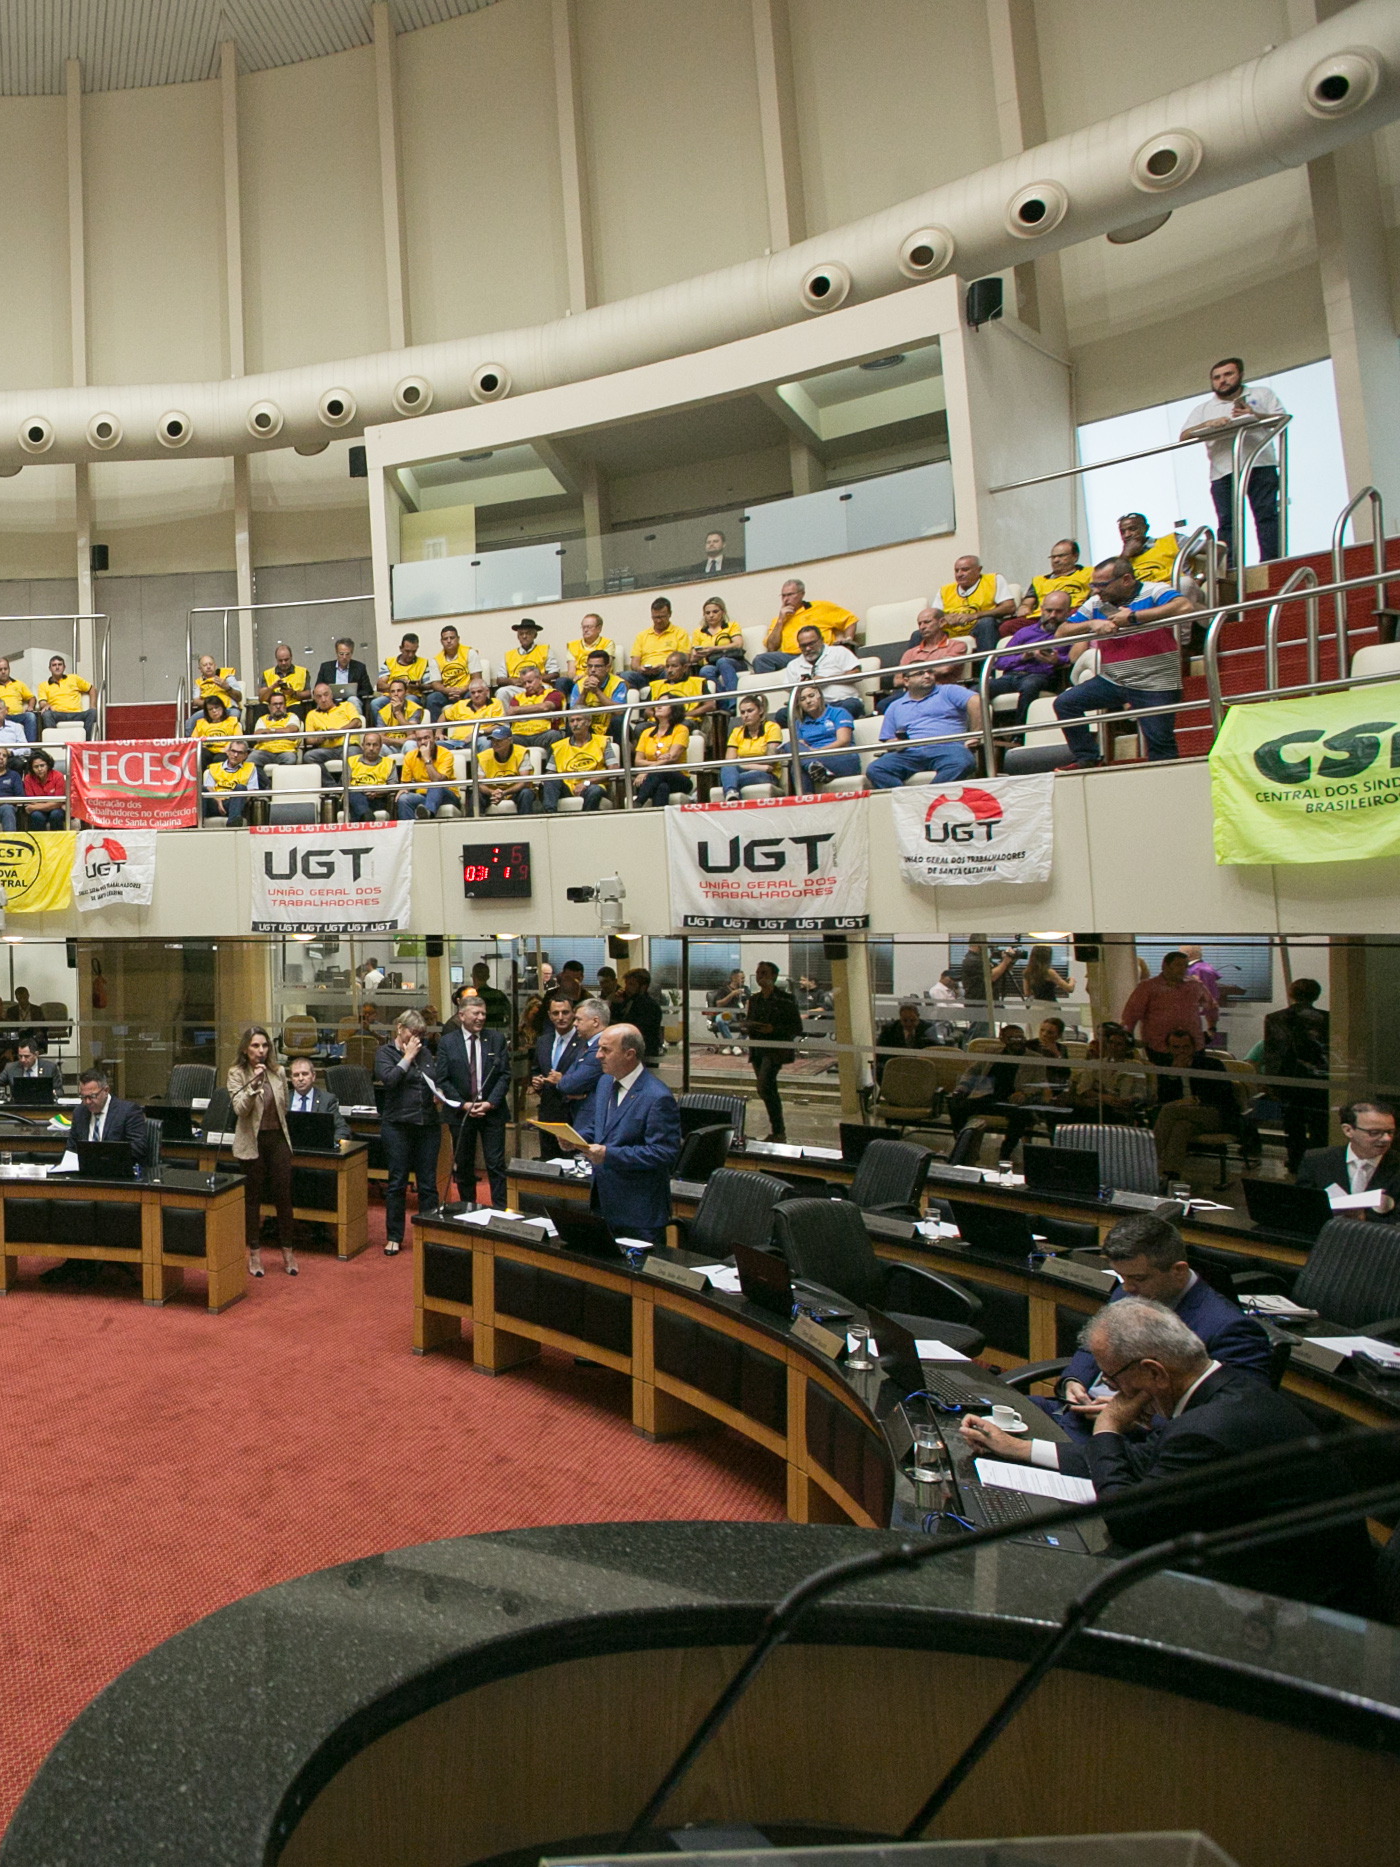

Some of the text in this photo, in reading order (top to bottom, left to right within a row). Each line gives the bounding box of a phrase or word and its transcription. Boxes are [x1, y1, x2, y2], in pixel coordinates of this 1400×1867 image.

[1256, 788, 1320, 803] CENTRAL
[1325, 783, 1358, 797] DOS
[1306, 793, 1400, 813] BRASILEIRO
[112, 817, 124, 825] de
[125, 818, 148, 828] Santa
[149, 818, 182, 828] Catarina
[925, 819, 1001, 843] UGT
[698, 833, 836, 875] UGT
[967, 850, 1026, 863] TRABALHADORES
[85, 862, 127, 878] UGT
[265, 846, 375, 883] UGT
[927, 867, 937, 875] DE
[938, 866, 963, 875] SANTA
[699, 876, 837, 890] UNIÃO GERAL DOS
[267, 886, 382, 896] UNIÃO GERAL DOS
[703, 887, 833, 899] TRABALHADORES
[272, 898, 380, 907] TRABALHADORES
[258, 922, 392, 932] UGT UGT UGT UGT UGT UGT
[687, 917, 865, 929] UGT UGT UGT UGT UGT
